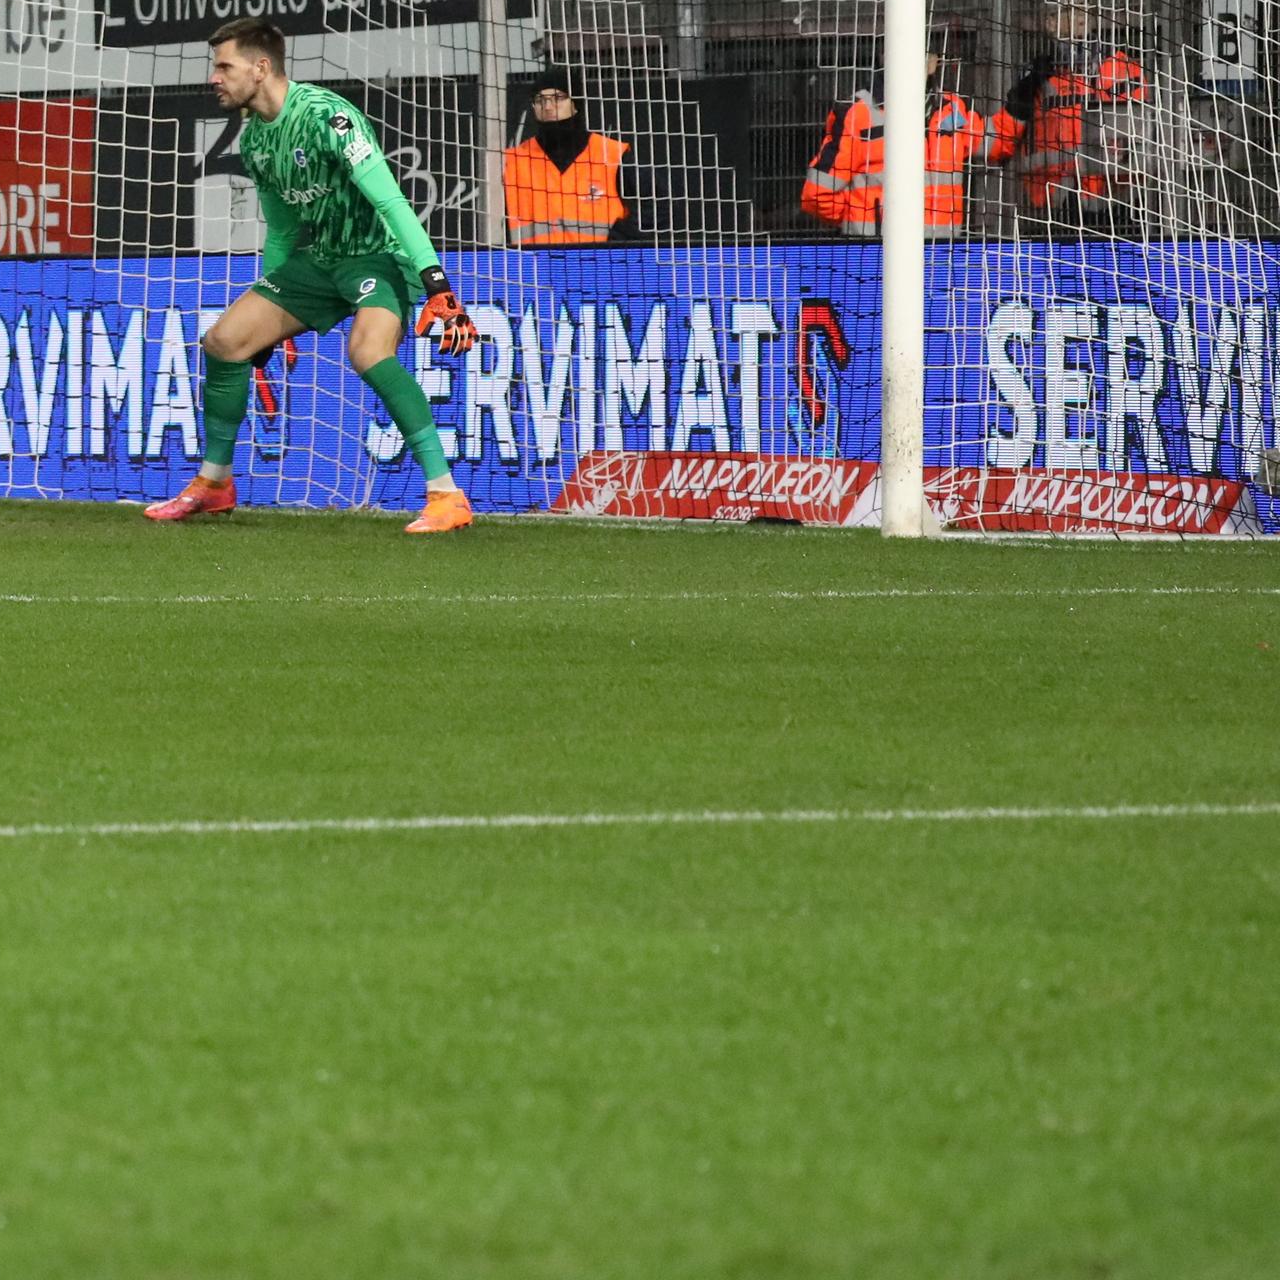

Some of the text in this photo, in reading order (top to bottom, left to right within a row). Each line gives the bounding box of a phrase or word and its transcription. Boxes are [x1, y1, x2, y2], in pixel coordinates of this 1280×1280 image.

[1217, 13, 1241, 64] B
[654, 458, 860, 508] NAPOLEON
[1000, 472, 1228, 529] NAPOLEON
